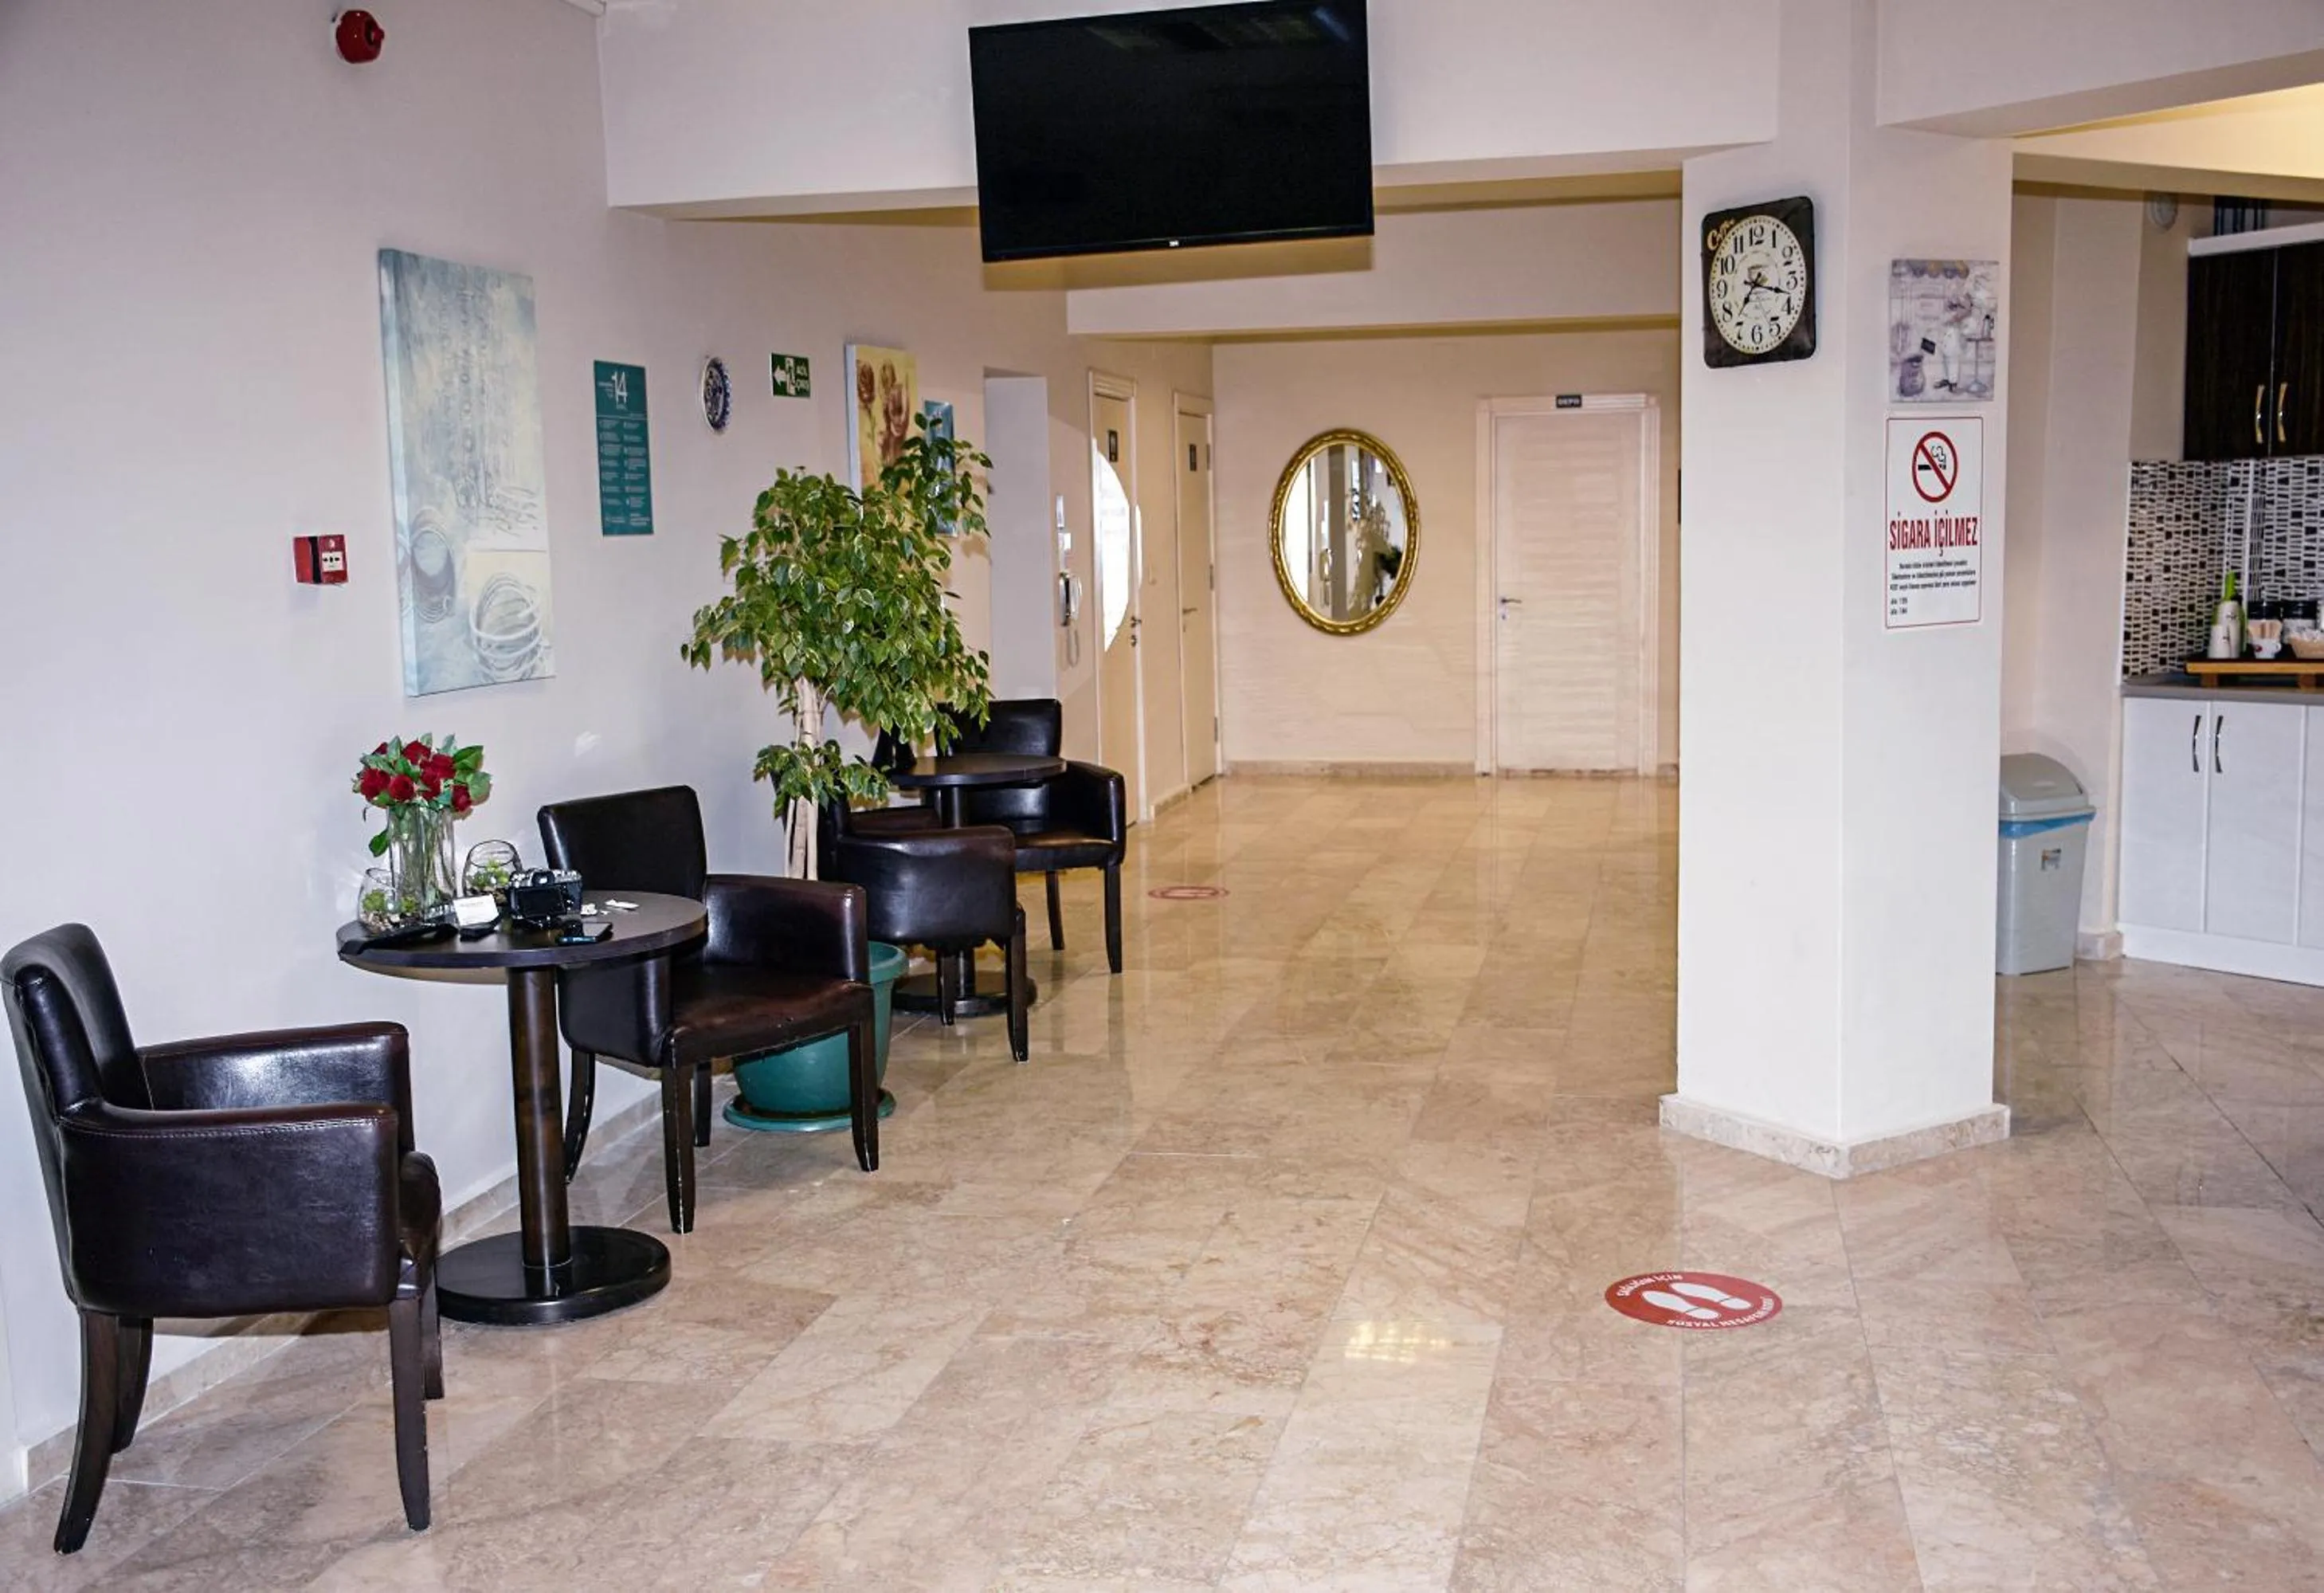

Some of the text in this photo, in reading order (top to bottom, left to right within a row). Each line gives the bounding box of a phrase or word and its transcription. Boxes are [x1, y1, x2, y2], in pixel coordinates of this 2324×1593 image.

[1734, 235, 1744, 254] 11
[1749, 226, 1765, 246] 12
[1771, 229, 1777, 248] 1
[1781, 245, 1793, 266] 2
[1720, 256, 1735, 276] 10
[1716, 280, 1728, 299] 9
[1785, 271, 1798, 290] 3
[1722, 301, 1734, 323] 8
[1781, 296, 1794, 316] 4
[1735, 322, 1744, 341] 7
[1751, 324, 1762, 344] 6
[1769, 316, 1781, 337] 5
[611, 371, 628, 404] 14
[1889, 510, 1978, 556] SİGARA İÇİLMEZ
